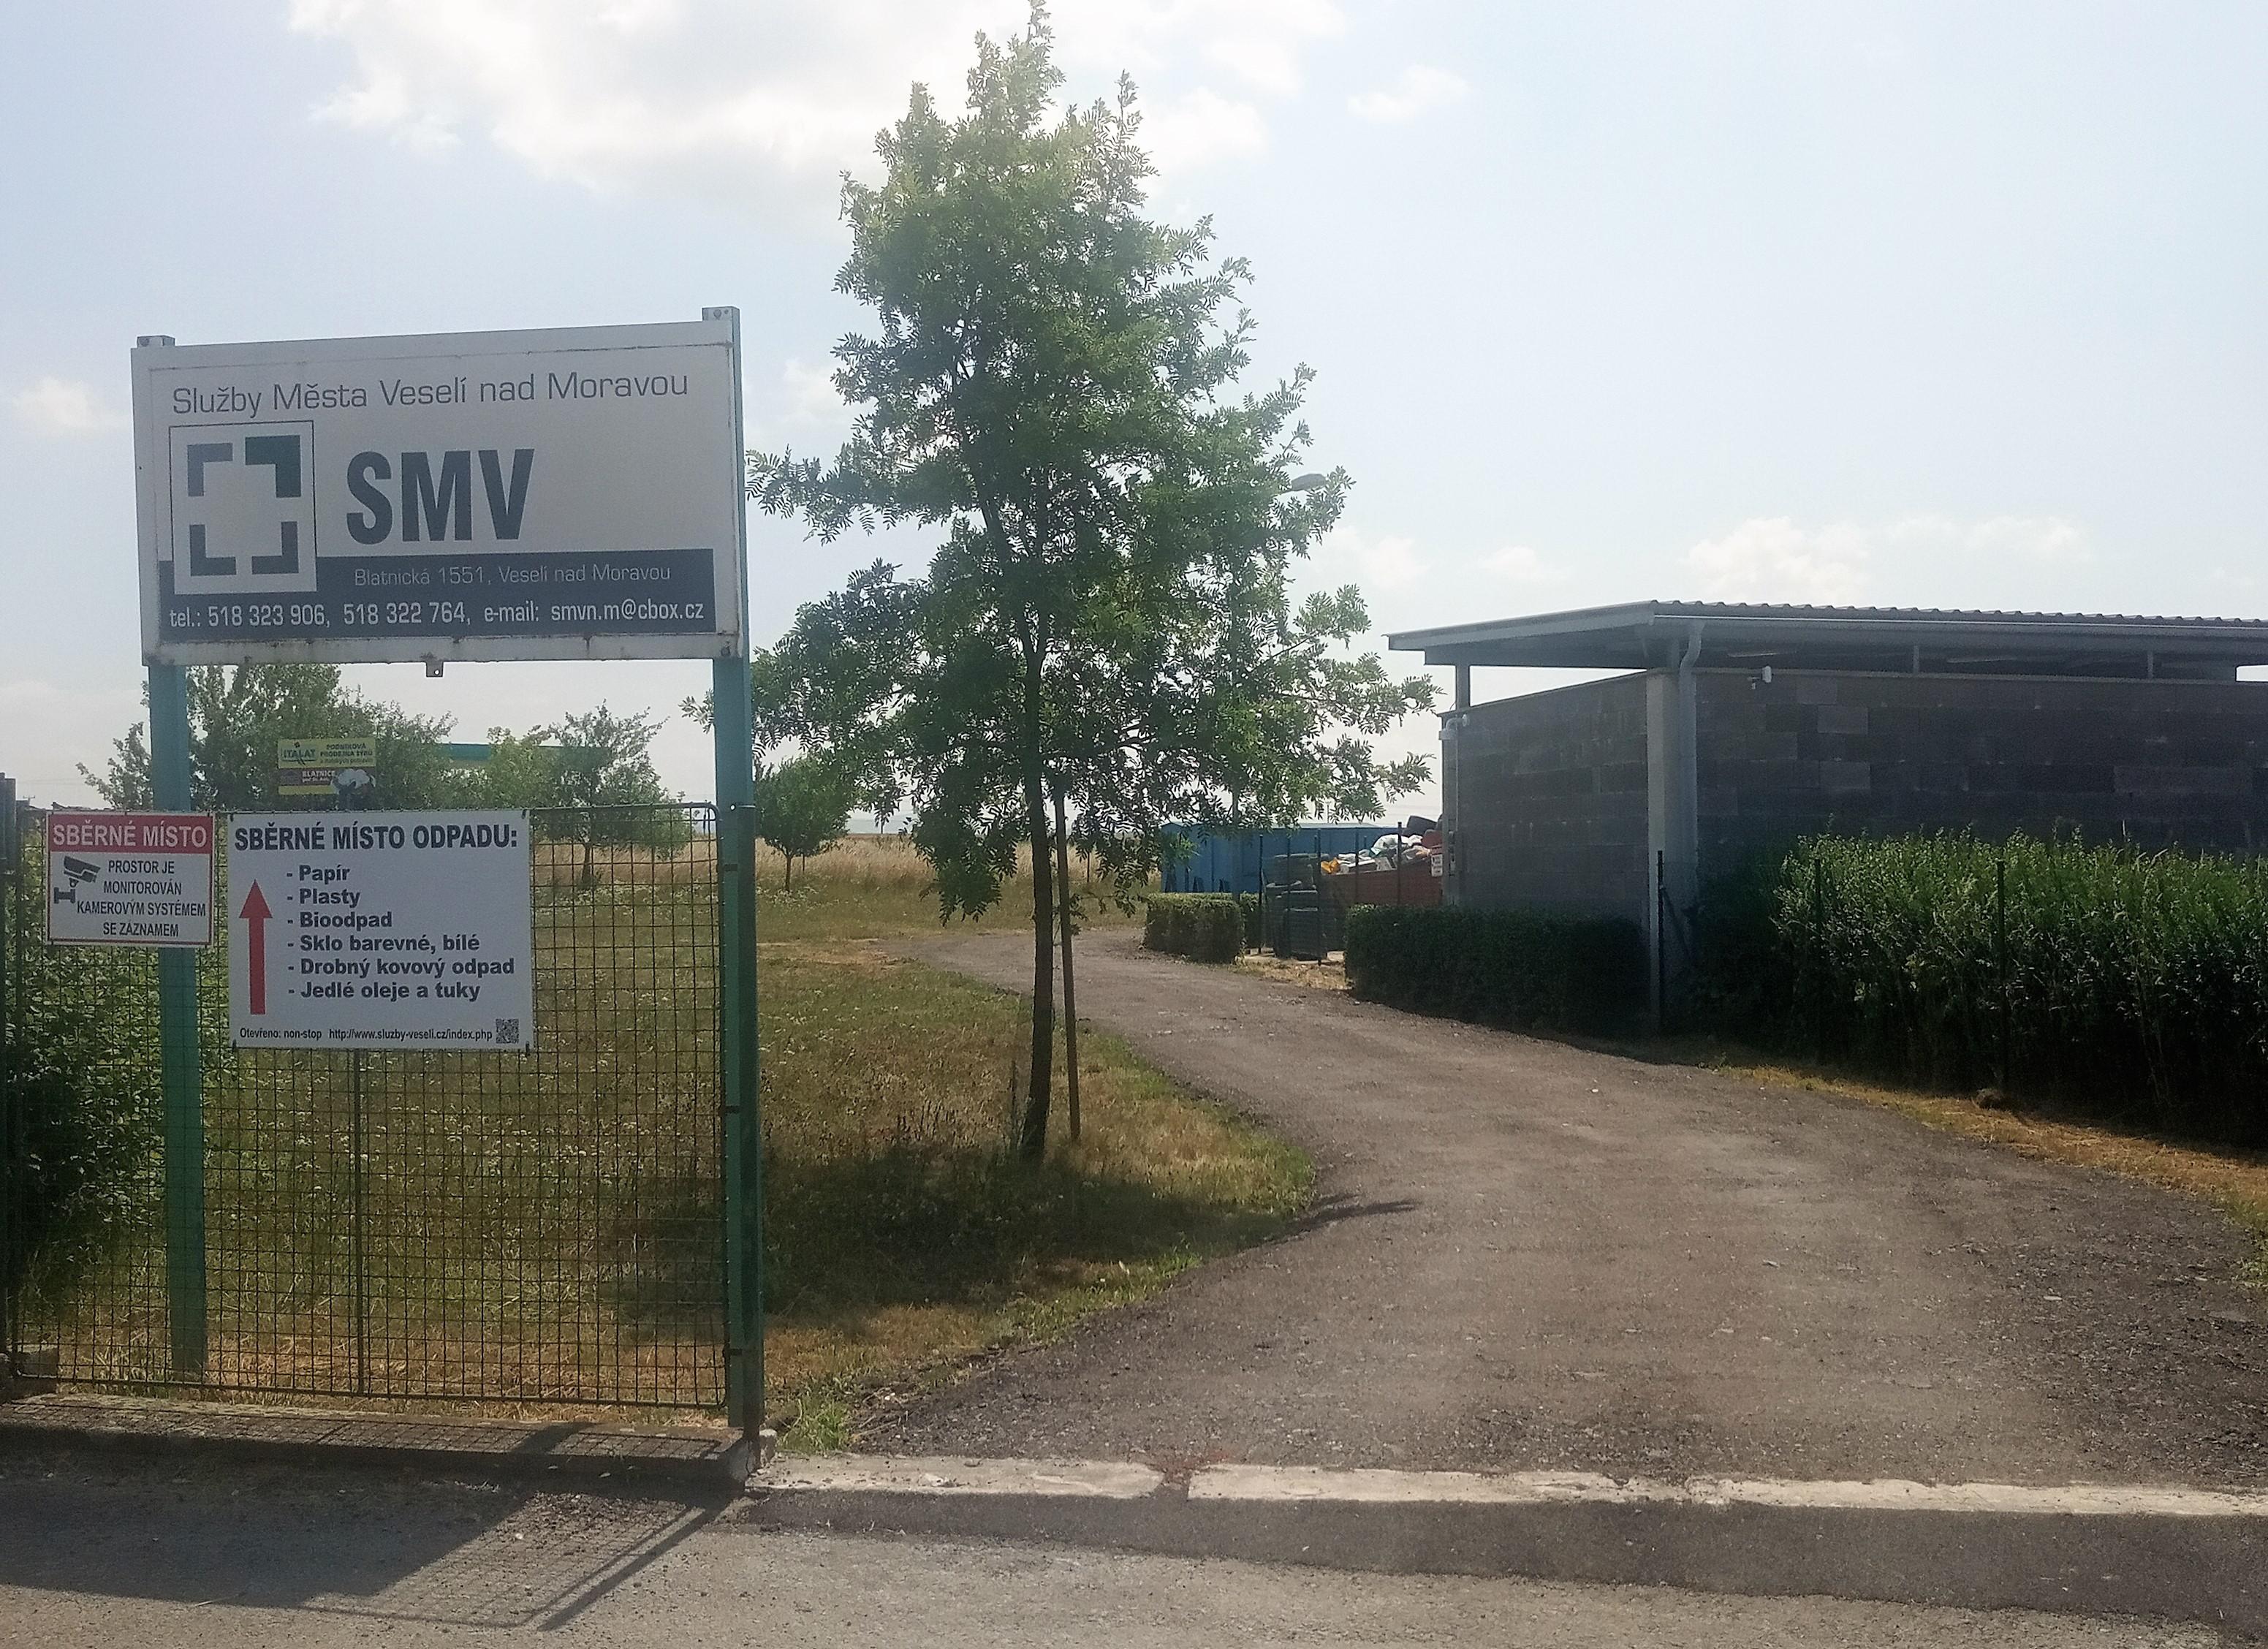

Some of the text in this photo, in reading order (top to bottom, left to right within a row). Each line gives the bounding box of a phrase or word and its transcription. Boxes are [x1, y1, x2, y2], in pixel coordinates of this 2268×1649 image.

[172, 371, 689, 419] Služby Města Veselí nad Moravou
[346, 448, 535, 546] SMV
[354, 564, 671, 586] Blatnická 1551, Veselí nad Moravou
[169, 598, 705, 628] tel.: 518 323 906, 518 322 764, e-mail: smvn.m@cbox.cz
[53, 819, 207, 848] SBĚRNÉ MÍSTO
[235, 821, 517, 851] SBĚRNÉ MÍSTO ODPADU:
[108, 860, 175, 874] PROSTOR JE
[298, 864, 351, 885] Papír
[103, 879, 182, 895] MONITOROVÁN
[77, 899, 206, 917] KAMEROVÝM SYSTÉMEM
[299, 888, 361, 909] Plasty
[103, 920, 179, 937] SE ZÁZNAMEM
[300, 911, 393, 931] Bioodpad
[300, 935, 343, 952] Sklo
[349, 934, 436, 955] barevné,
[443, 934, 480, 951] bílé
[300, 958, 370, 979] Drobný
[377, 958, 446, 979] kovový
[452, 958, 515, 979] odpad
[300, 981, 354, 998] Jedlé
[361, 982, 410, 1002] oleje
[416, 986, 429, 998] a
[434, 982, 480, 1002] tuky
[284, 1028, 322, 1041] non-stop
[328, 1028, 493, 1042] http://www.sluzby-veseli.cz/index.php
